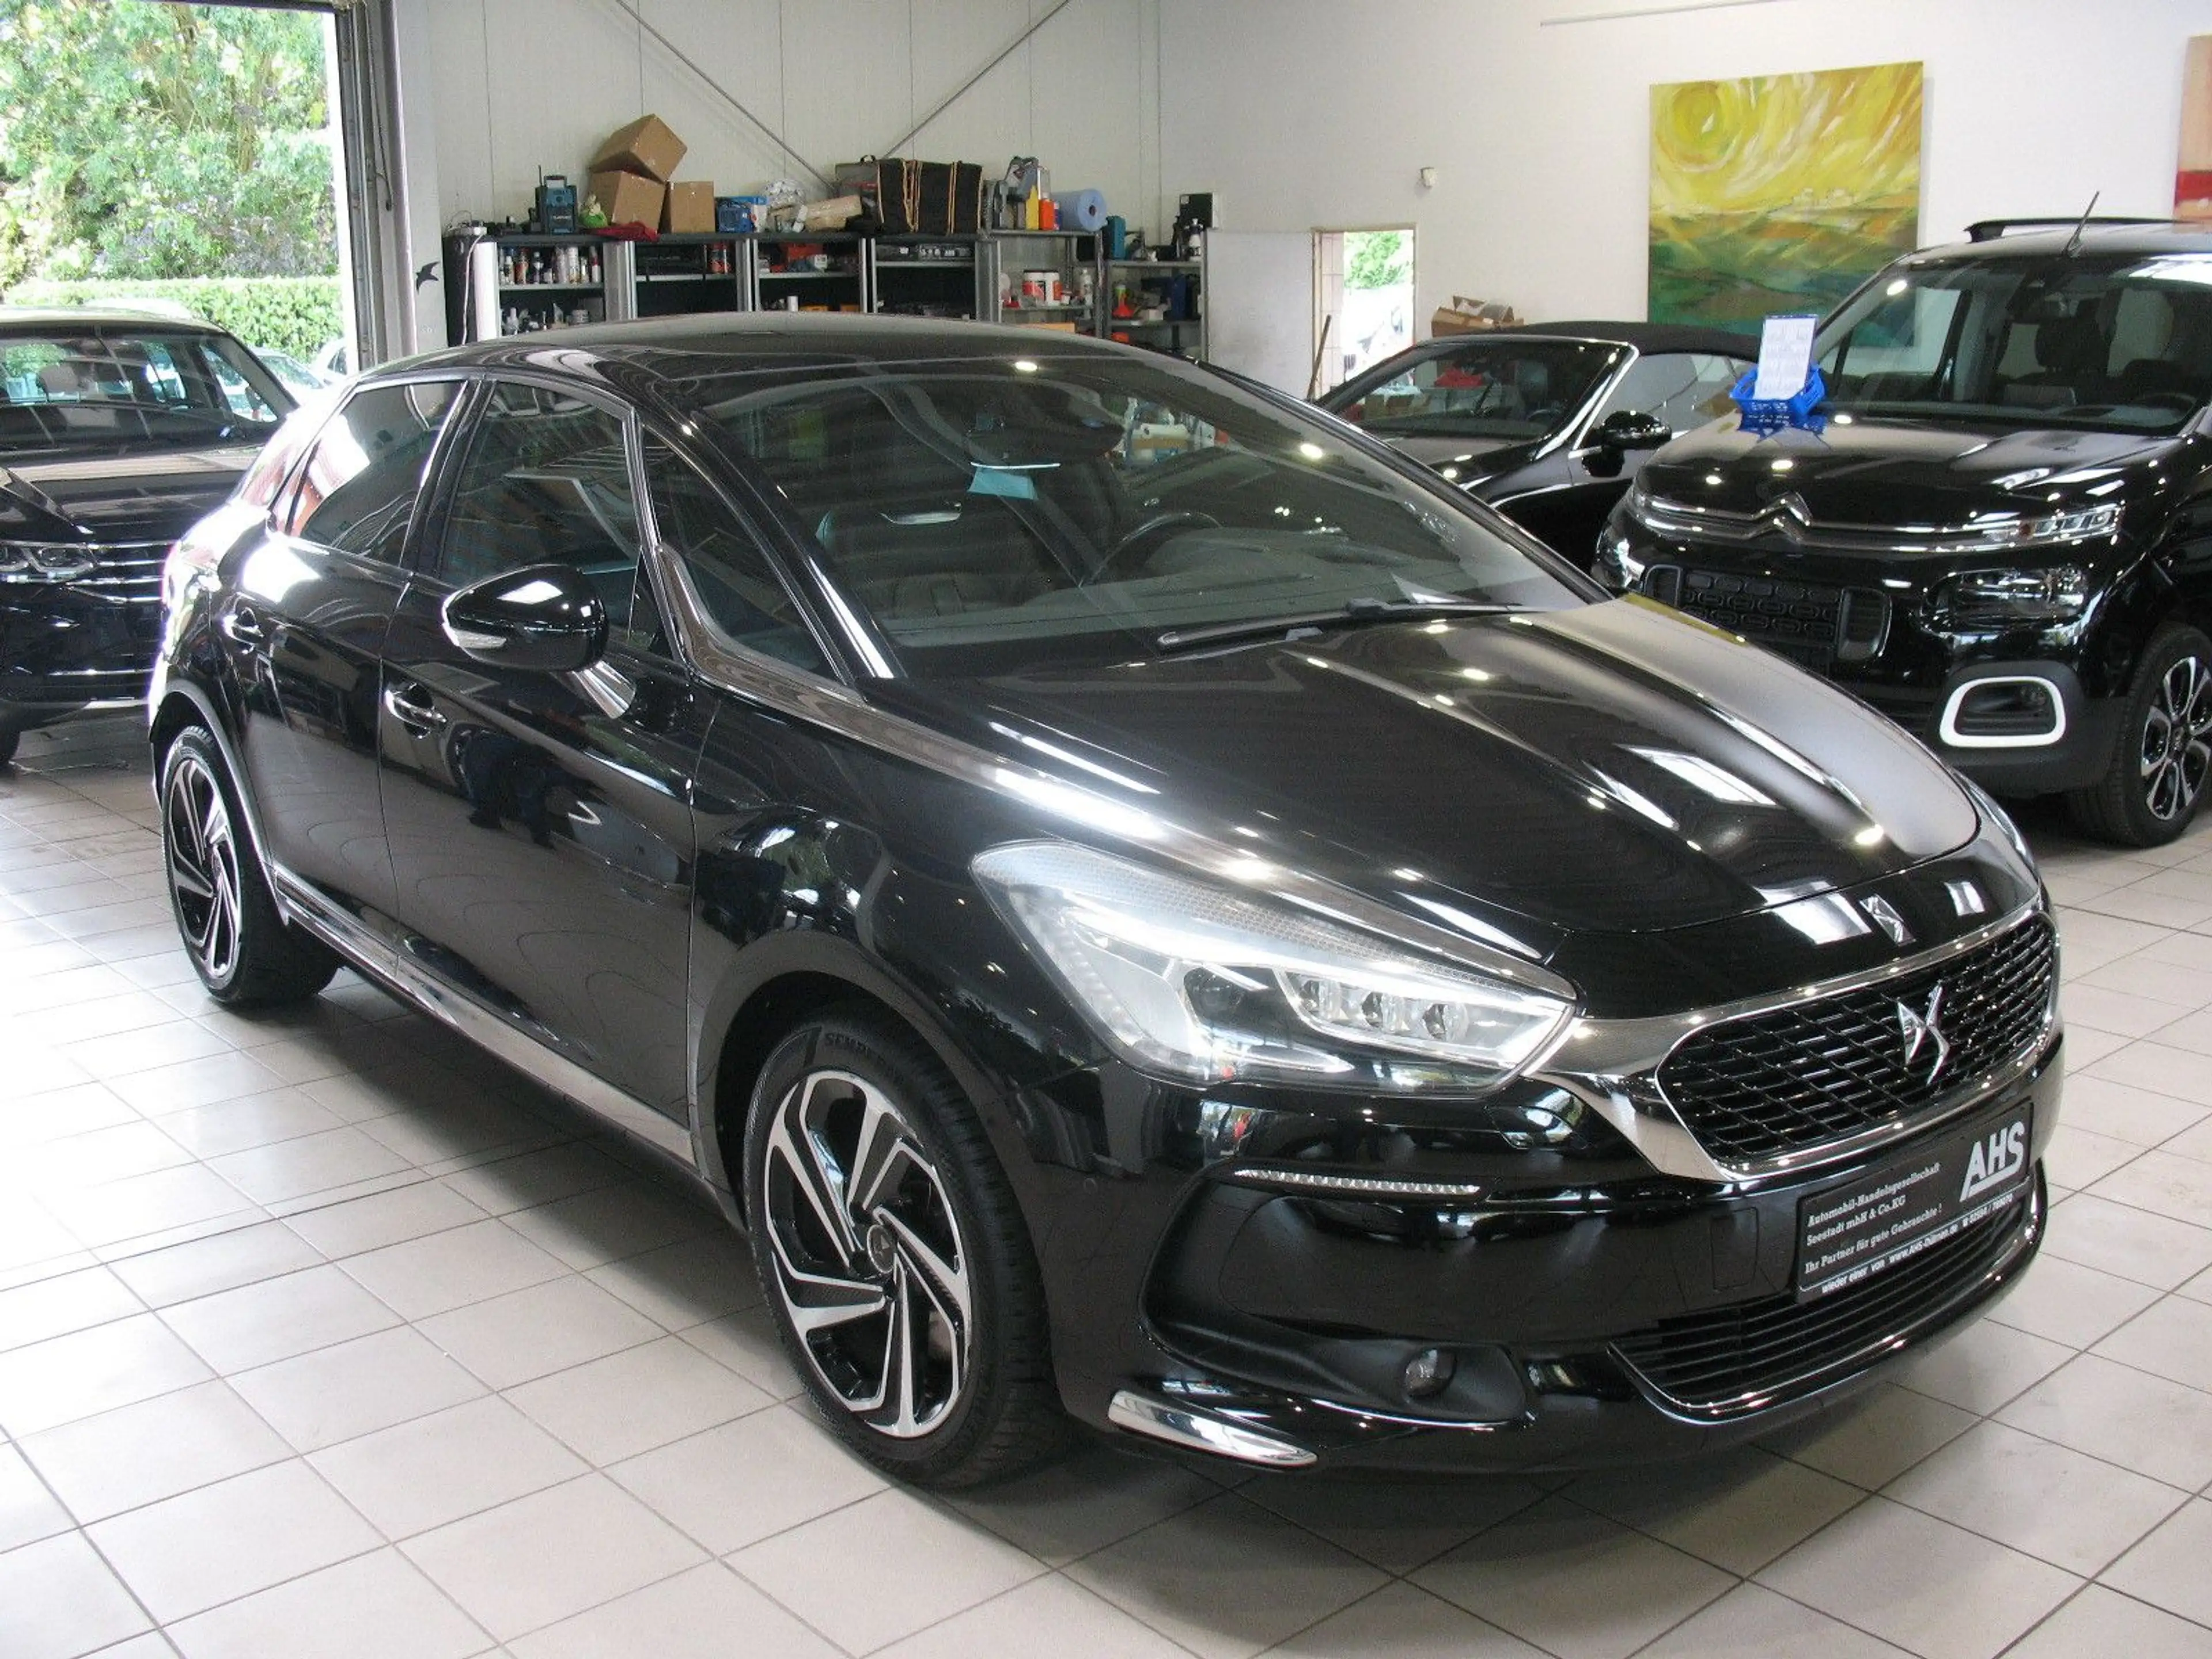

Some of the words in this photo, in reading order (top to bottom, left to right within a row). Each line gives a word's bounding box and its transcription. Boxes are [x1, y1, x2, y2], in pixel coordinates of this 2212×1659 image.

[1960, 1122, 2025, 1202] AHS
[1846, 1210, 1868, 1228] mbH
[1869, 1206, 1876, 1219] &
[1805, 1260, 1820, 1274] Ihr
[1821, 1244, 1855, 1267] Partner
[1856, 1238, 1869, 1252] für
[1871, 1230, 1889, 1248] gute
